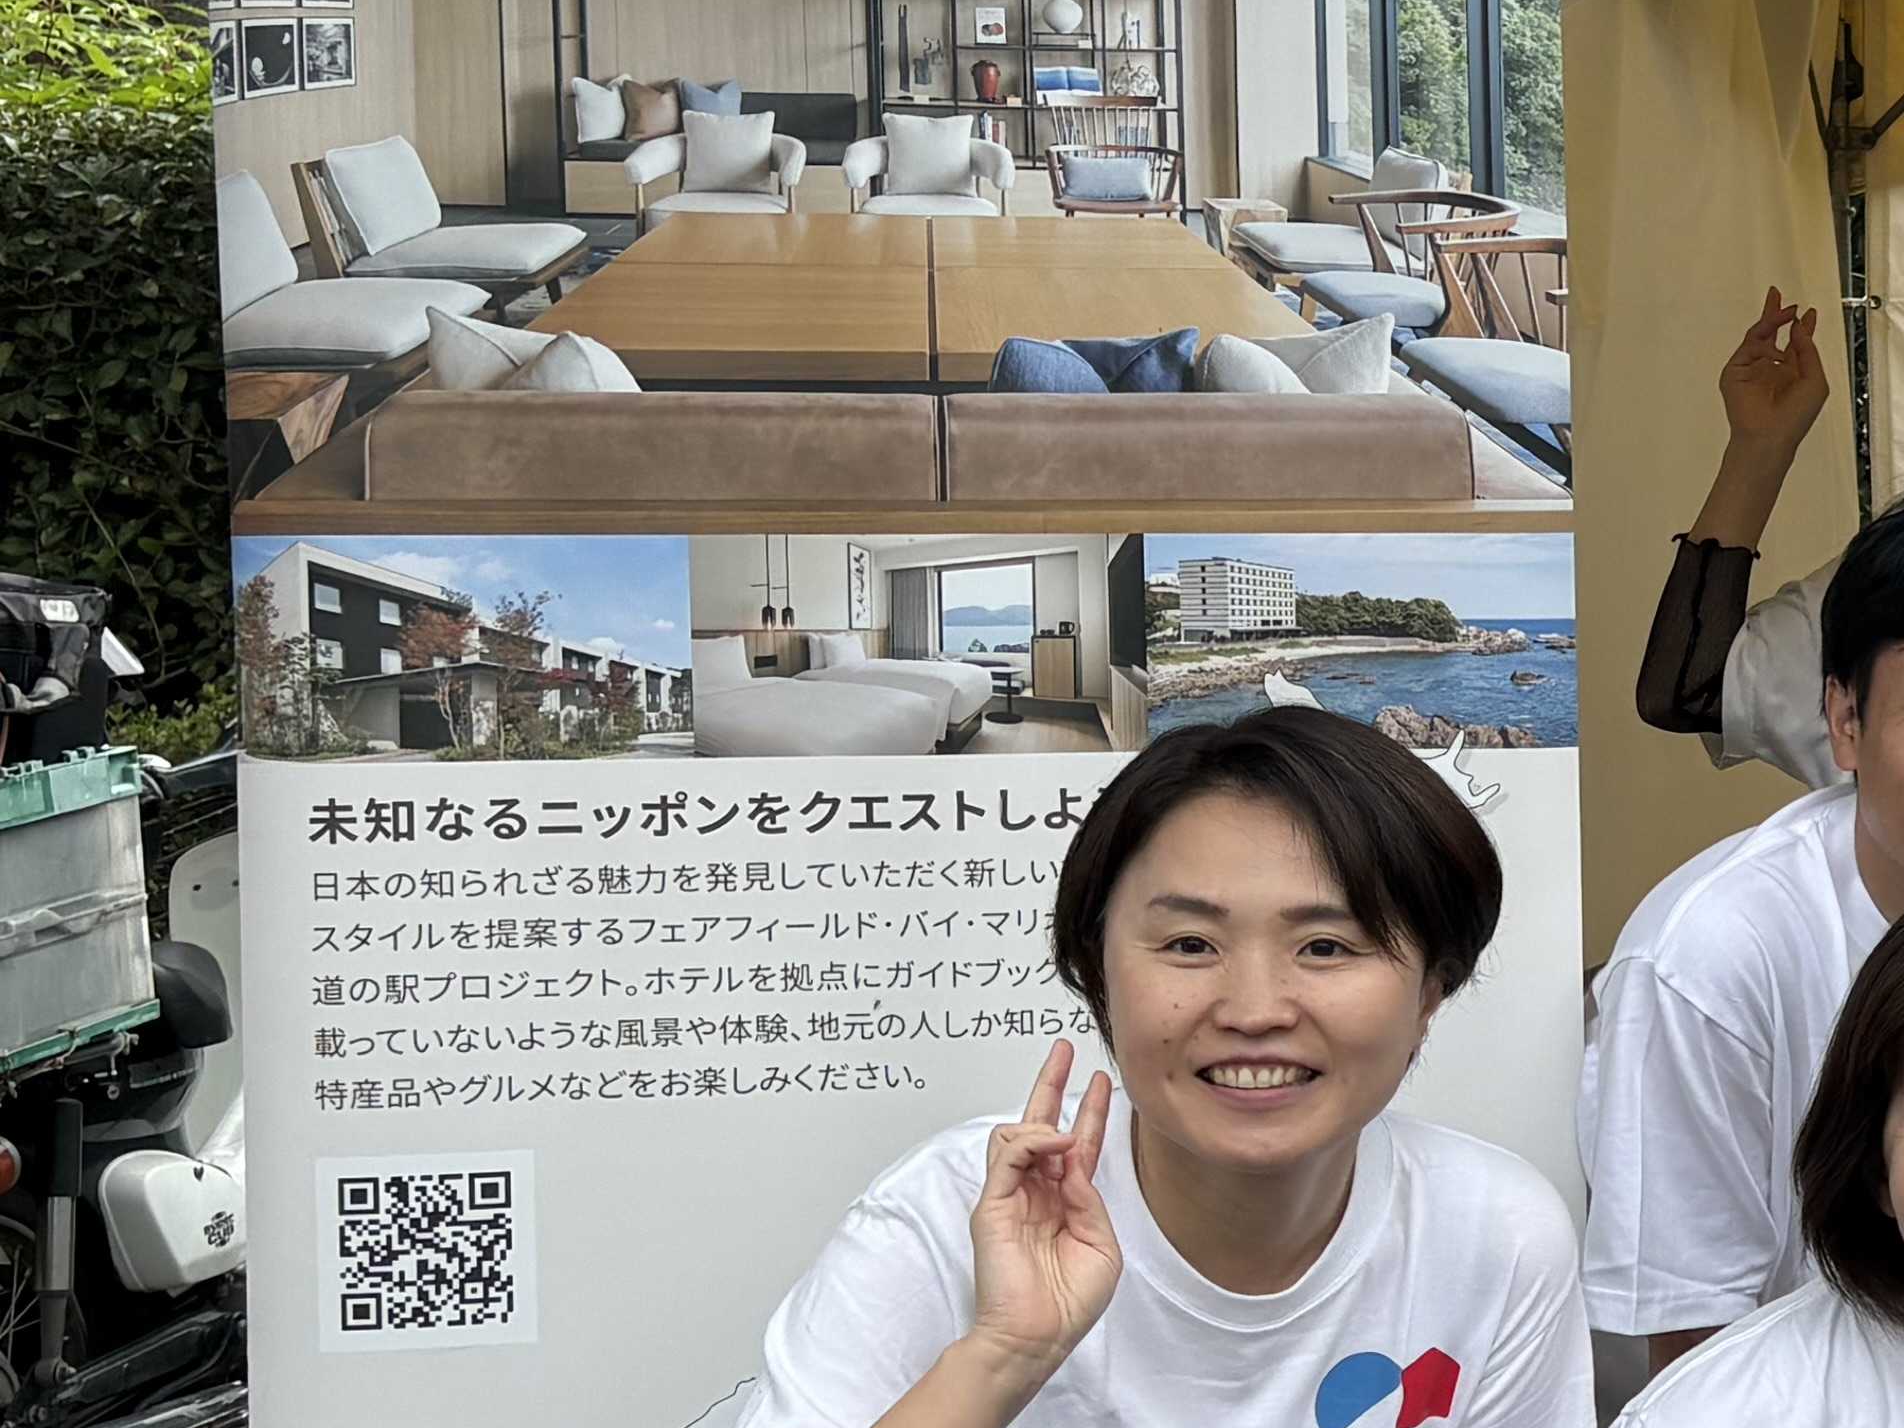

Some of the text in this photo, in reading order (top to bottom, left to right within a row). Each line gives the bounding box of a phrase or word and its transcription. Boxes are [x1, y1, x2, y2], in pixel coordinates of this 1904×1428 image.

[308, 788, 1108, 845] 未知なるニッポンをクエストしよ
[314, 1062, 926, 1111] 特産品やグルメなどをお楽しみください。
